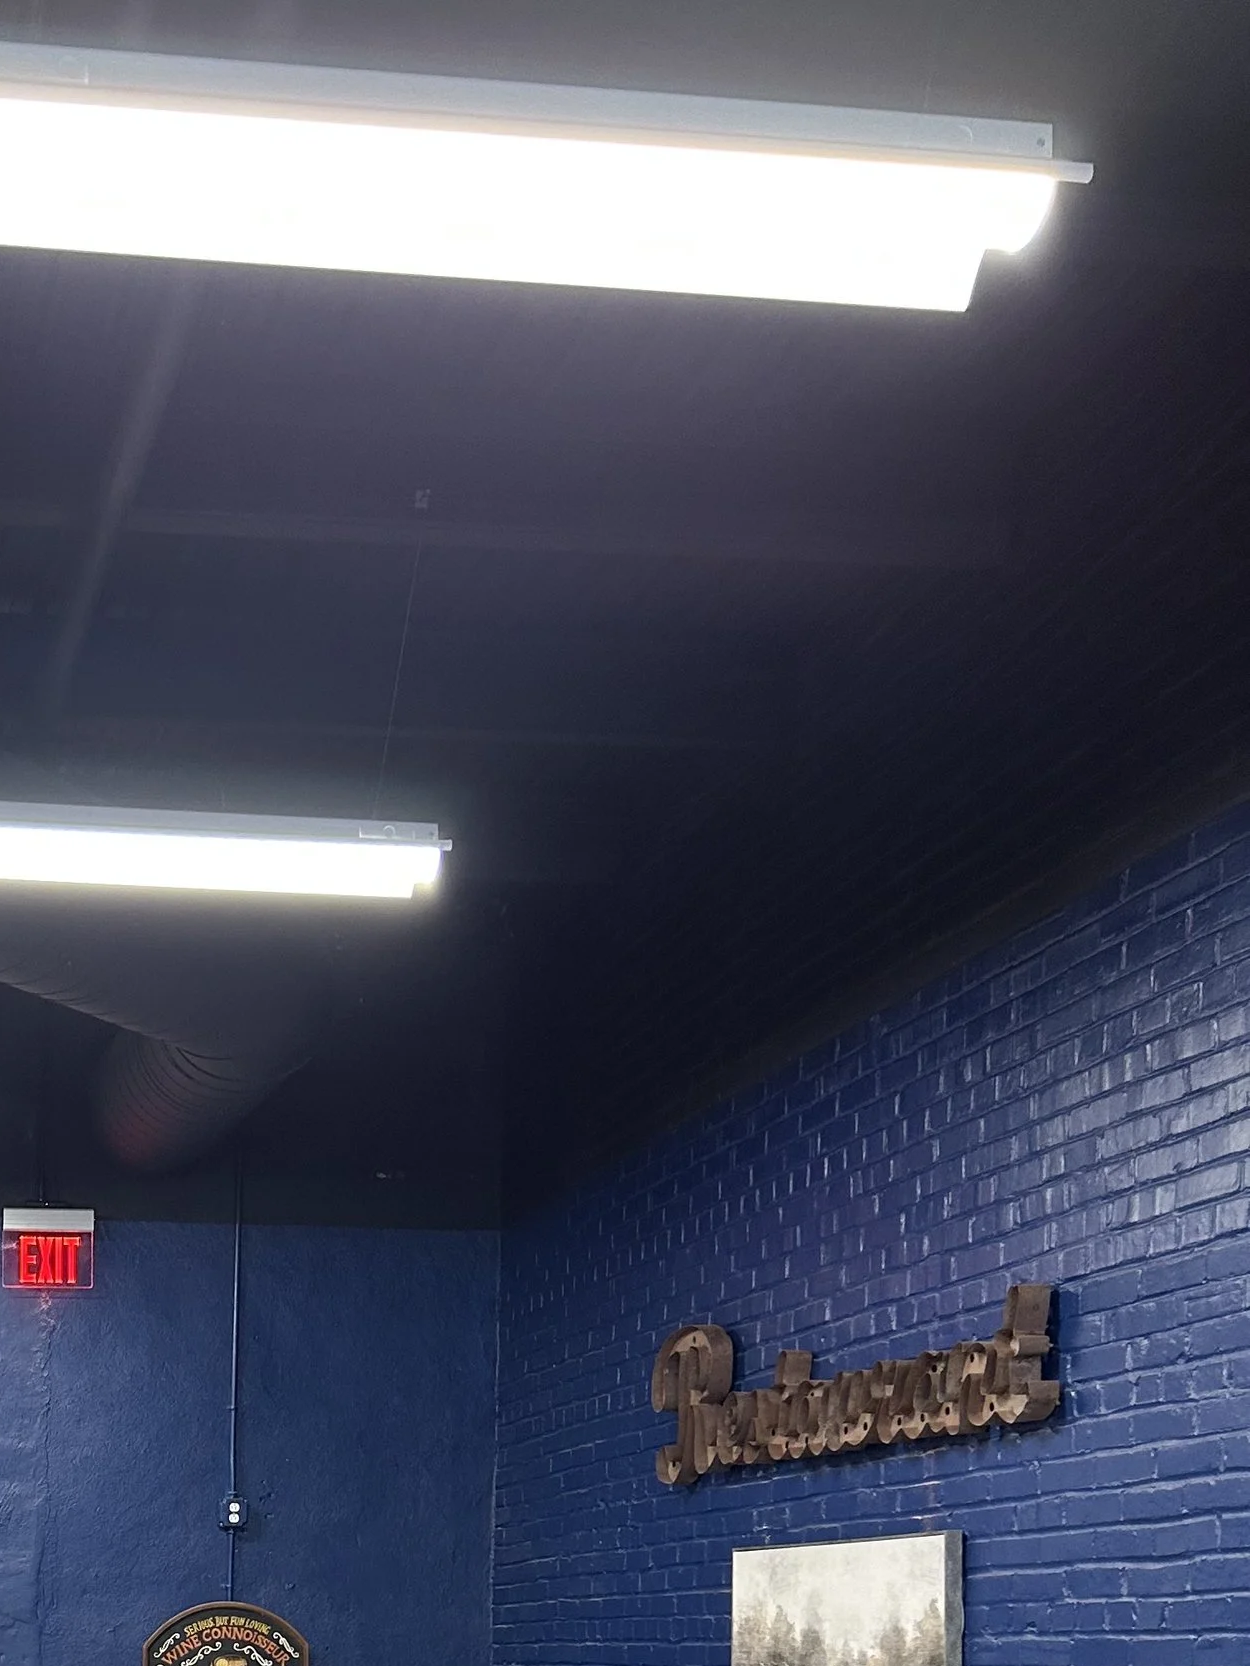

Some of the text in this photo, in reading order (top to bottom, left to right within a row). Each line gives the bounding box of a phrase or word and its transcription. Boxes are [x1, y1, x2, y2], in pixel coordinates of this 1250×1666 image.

[19, 1235, 81, 1284] EXIT
[184, 1616, 271, 1636] SERIOUS BUT FUN LOVING
[161, 1635, 202, 1665] WINE
